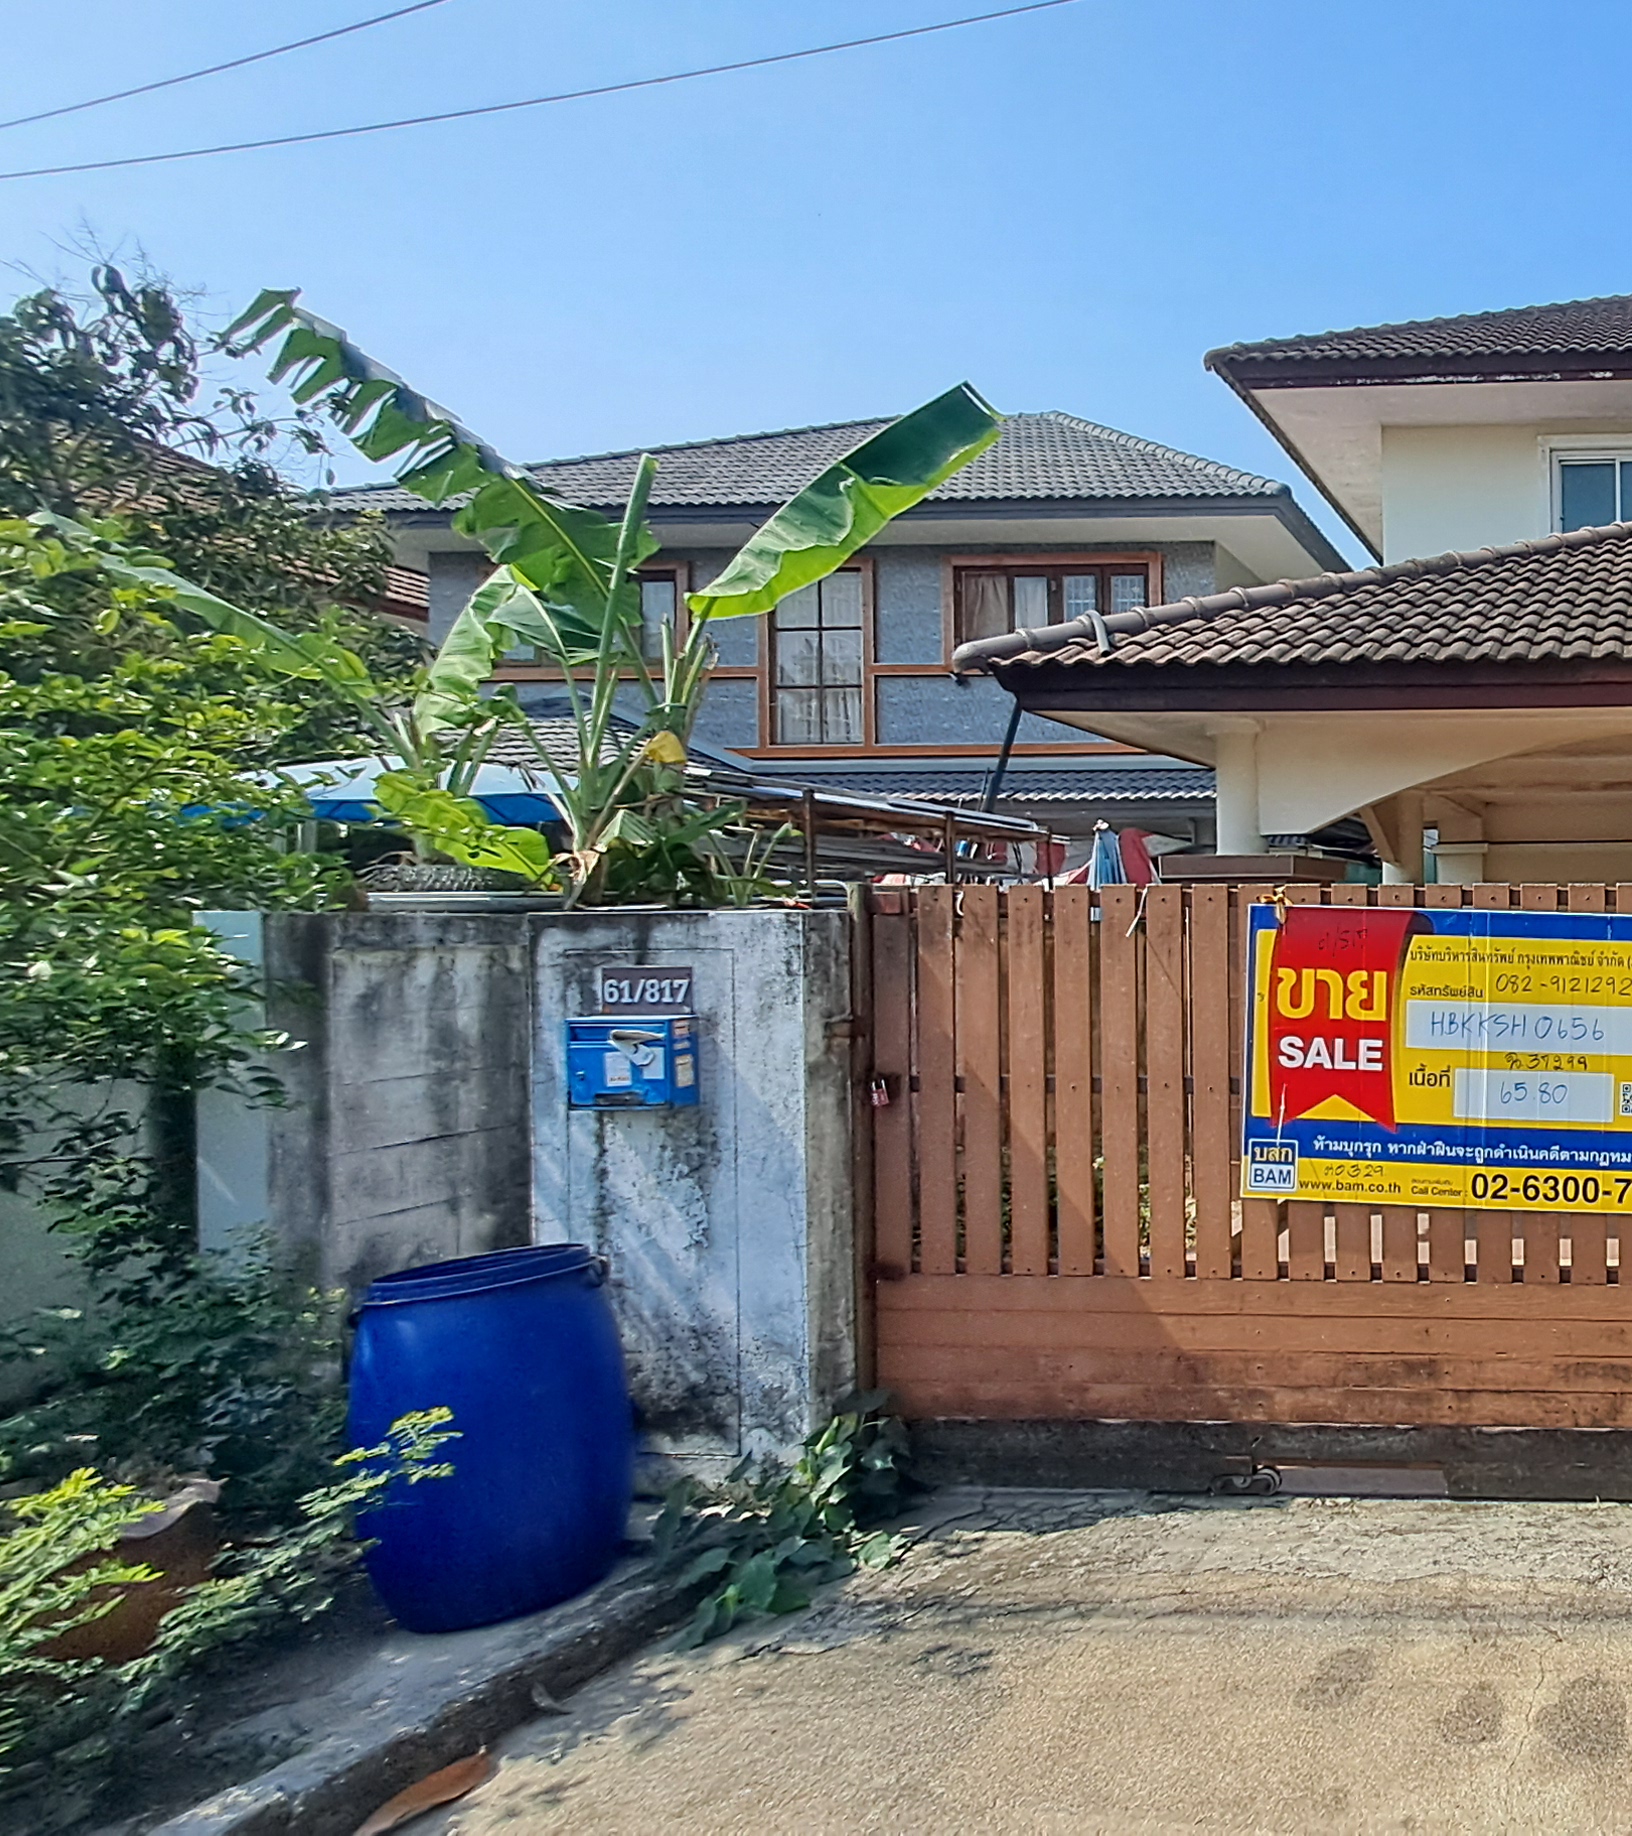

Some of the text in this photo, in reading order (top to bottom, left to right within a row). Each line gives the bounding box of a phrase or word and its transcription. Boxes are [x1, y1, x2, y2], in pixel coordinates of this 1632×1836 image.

[1517, 949, 1596, 970] กรุงเทพพาณิชย์
[1597, 950, 1625, 967] จำกัด
[604, 979, 690, 1003] 61/817
[1277, 967, 1387, 1021] ขาย
[1409, 984, 1485, 999] รหัสทรัพย์สิน
[1278, 1036, 1384, 1071] SALE
[1408, 1062, 1451, 1088] เนื้อที่
[1499, 1081, 1568, 1104] 65.80
[1254, 1145, 1293, 1164] บสก
[1313, 1135, 1382, 1159] ห้ามบุกรุก
[1253, 1168, 1292, 1185] BAM
[1299, 1179, 1401, 1194] www.bam.co.th
